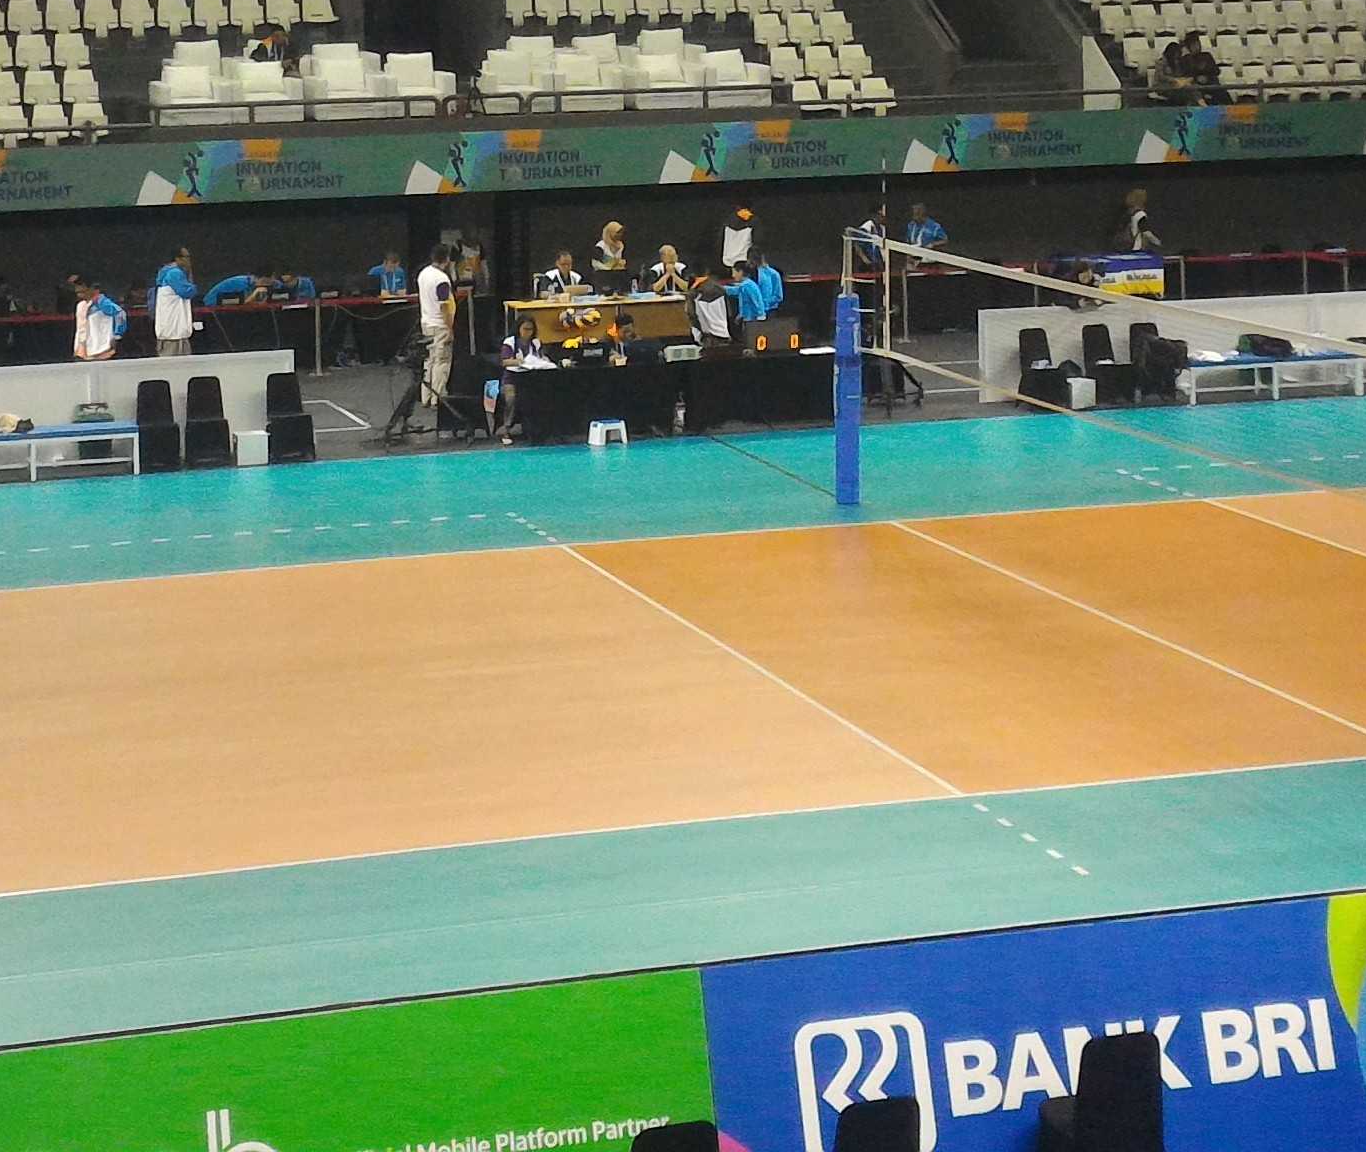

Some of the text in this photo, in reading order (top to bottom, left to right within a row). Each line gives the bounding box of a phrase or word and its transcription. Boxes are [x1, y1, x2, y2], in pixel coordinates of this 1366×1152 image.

[748, 139, 827, 154] INVITATION
[498, 150, 581, 164] INVITATION
[236, 160, 322, 176] INVITATION
[1201, 998, 1337, 1085] BRI
[495, 1125, 588, 1152] Platform
